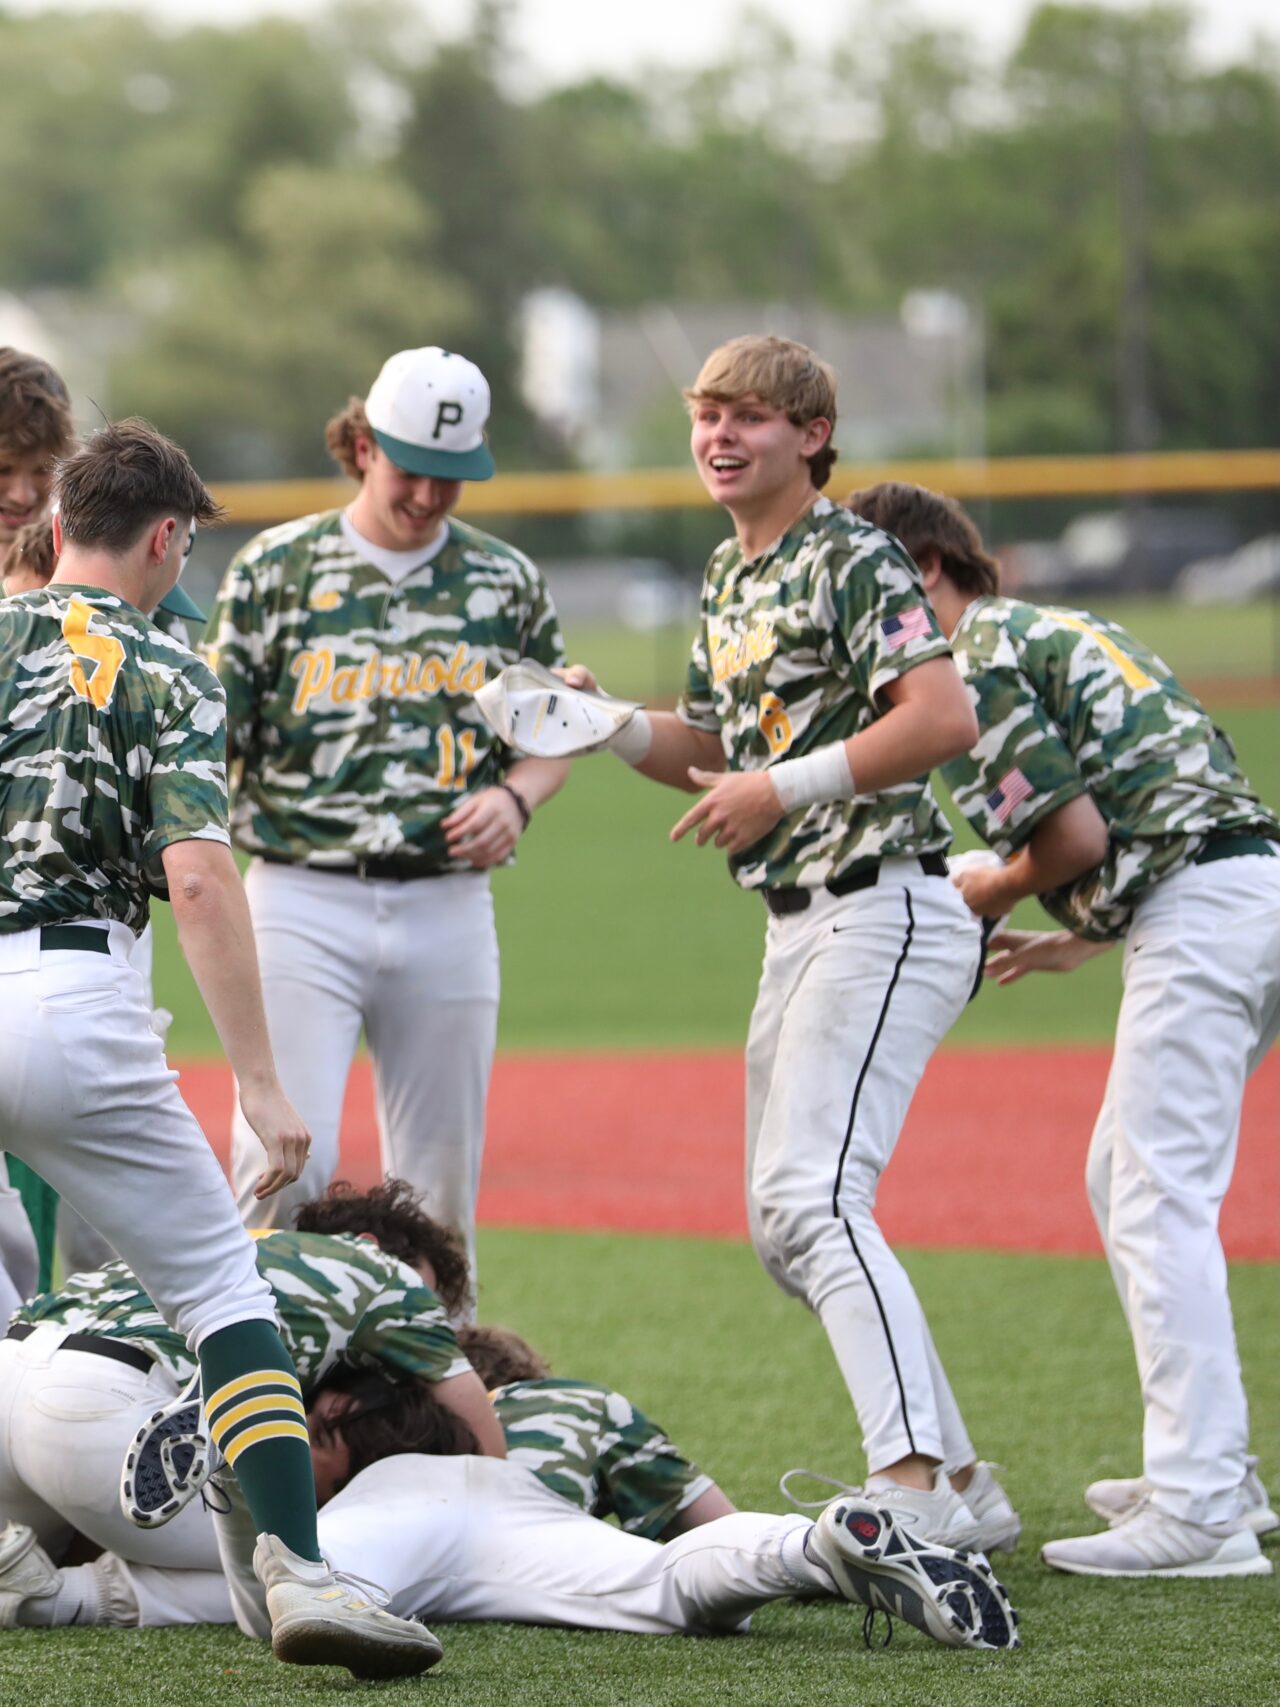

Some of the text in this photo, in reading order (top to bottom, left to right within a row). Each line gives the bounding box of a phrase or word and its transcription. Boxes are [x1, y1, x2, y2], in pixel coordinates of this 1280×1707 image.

[431, 400, 464, 440] P
[61, 600, 126, 712] 5
[291, 640, 487, 715] Patriots
[436, 723, 477, 790] 11
